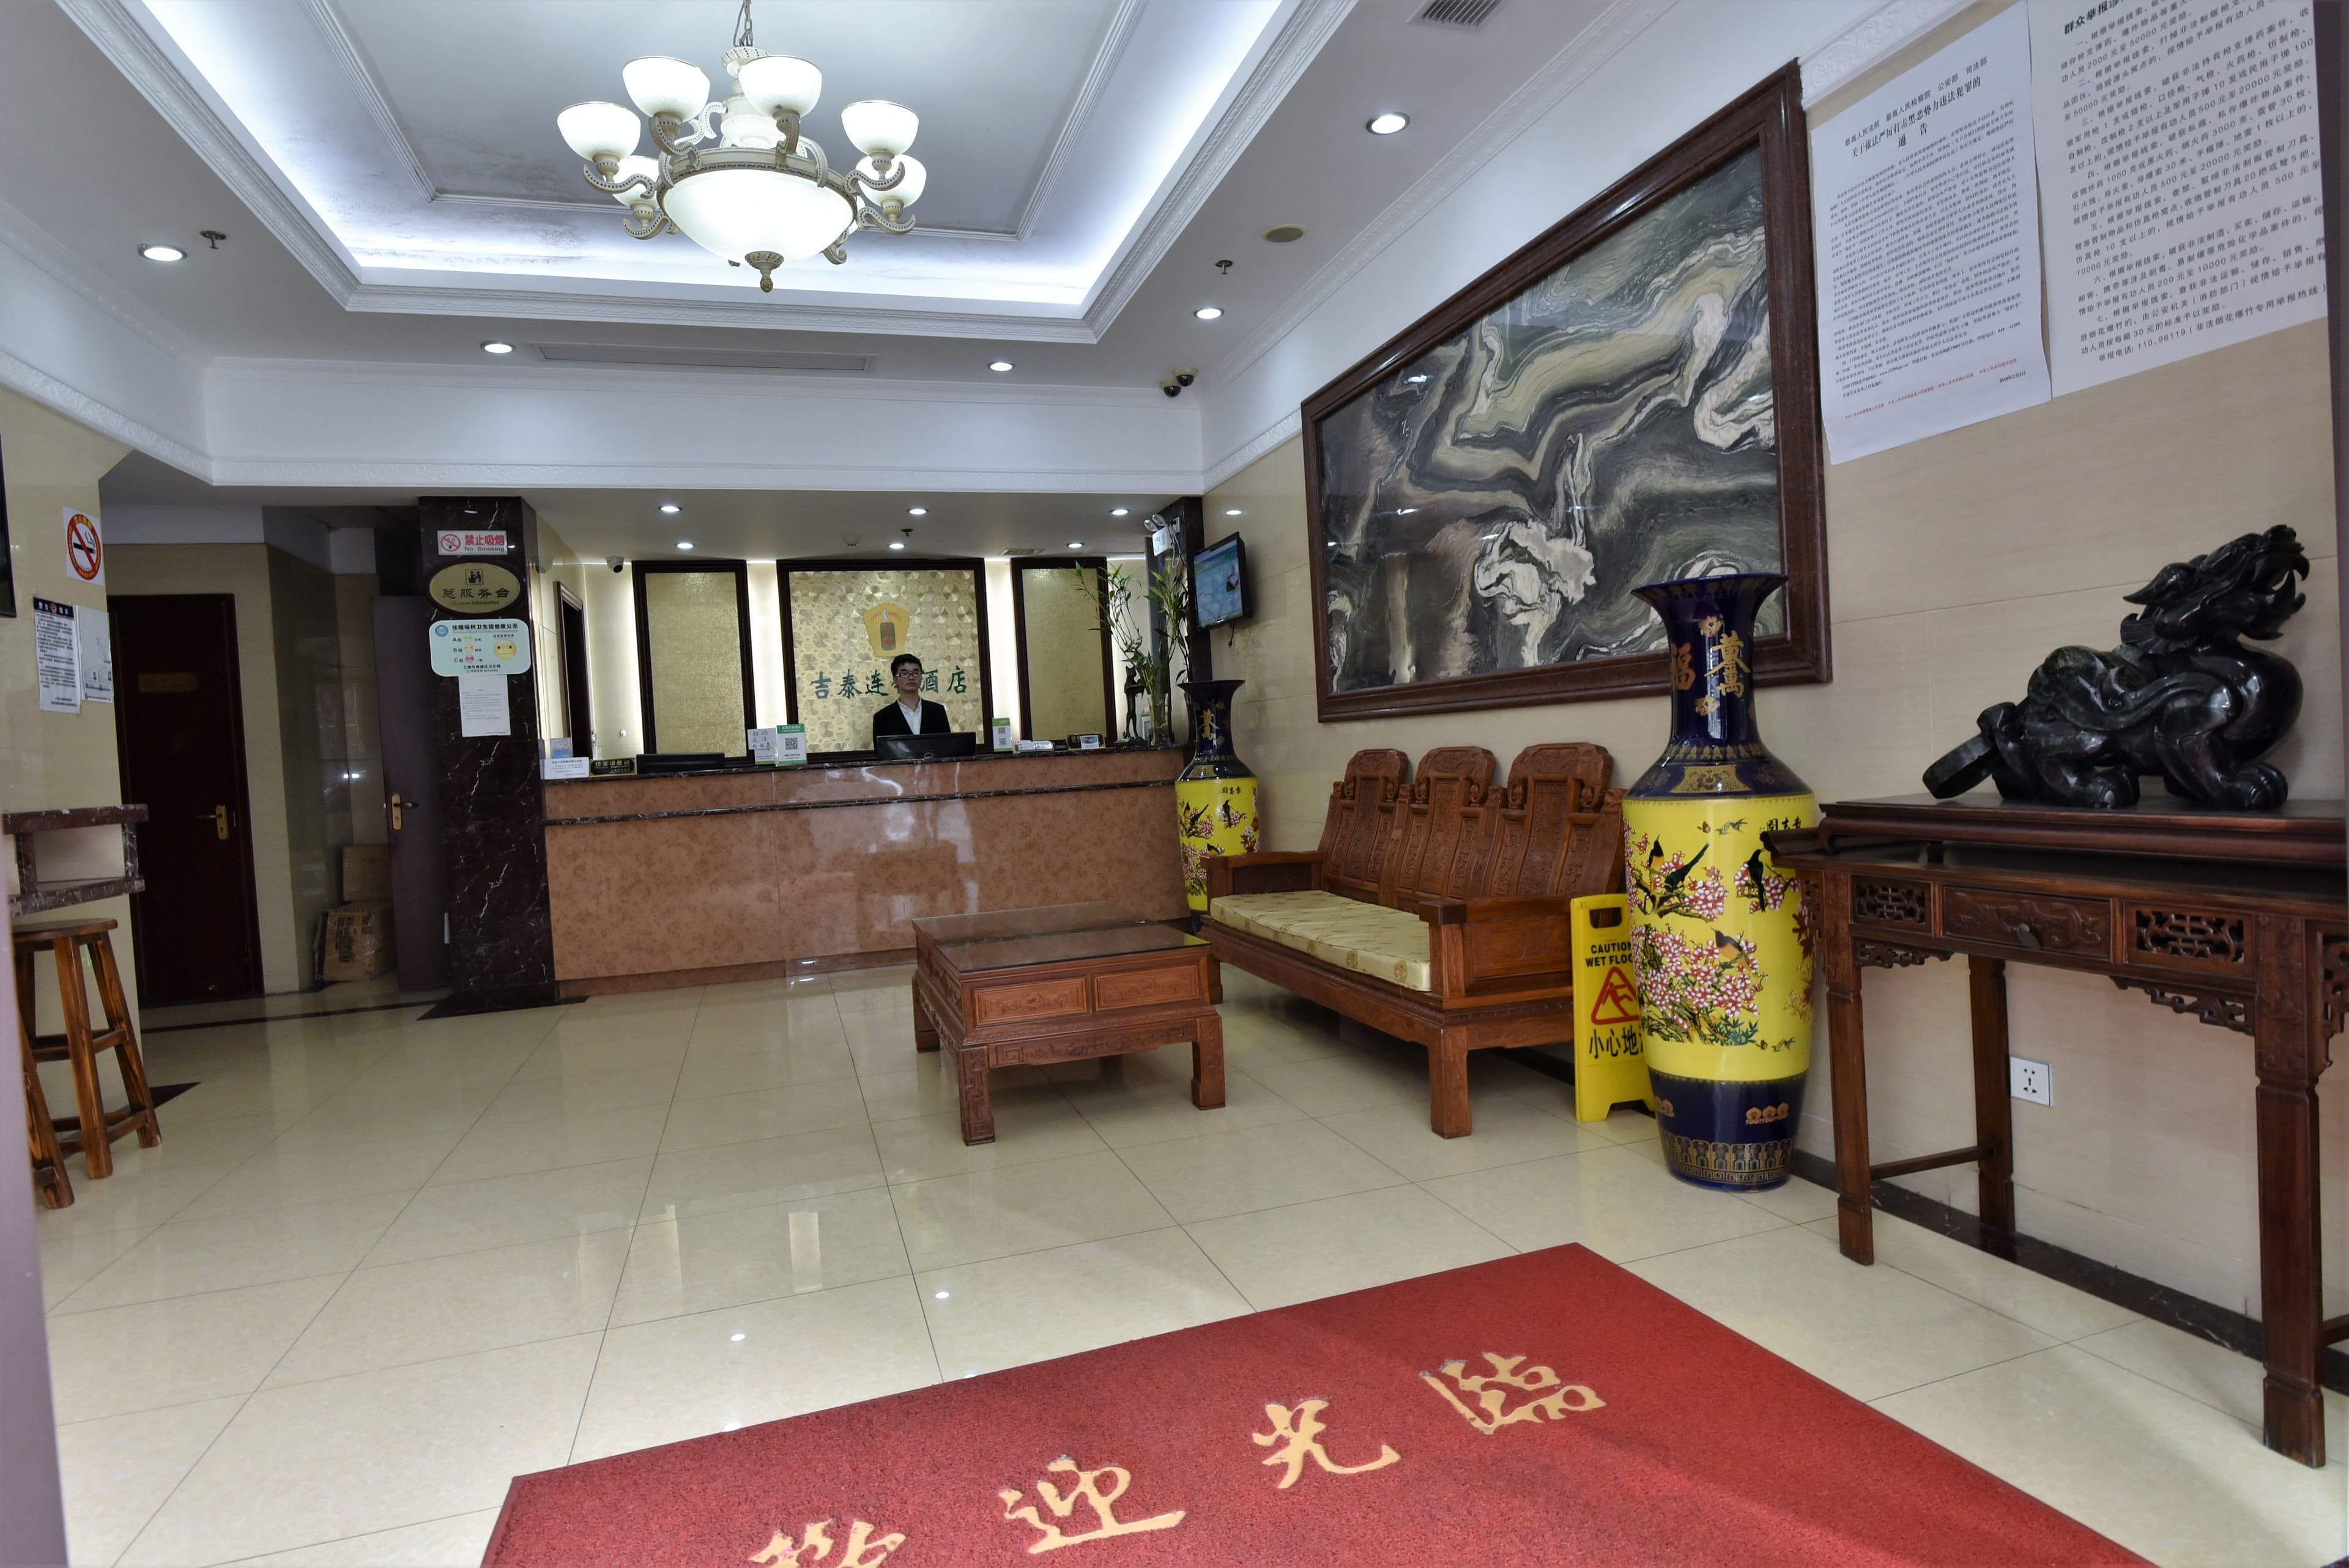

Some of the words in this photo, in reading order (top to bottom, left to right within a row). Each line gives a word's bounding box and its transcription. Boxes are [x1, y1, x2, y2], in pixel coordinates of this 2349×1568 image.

[2065, 0, 2124, 35] 群众举报涉
[465, 534, 505, 546] 禁止吸烟
[811, 665, 968, 699] 吉泰连酒店
[1586, 956, 1606, 967] WET
[1609, 954, 1633, 965] FLOO
[1589, 1025, 1644, 1060] 小心地
